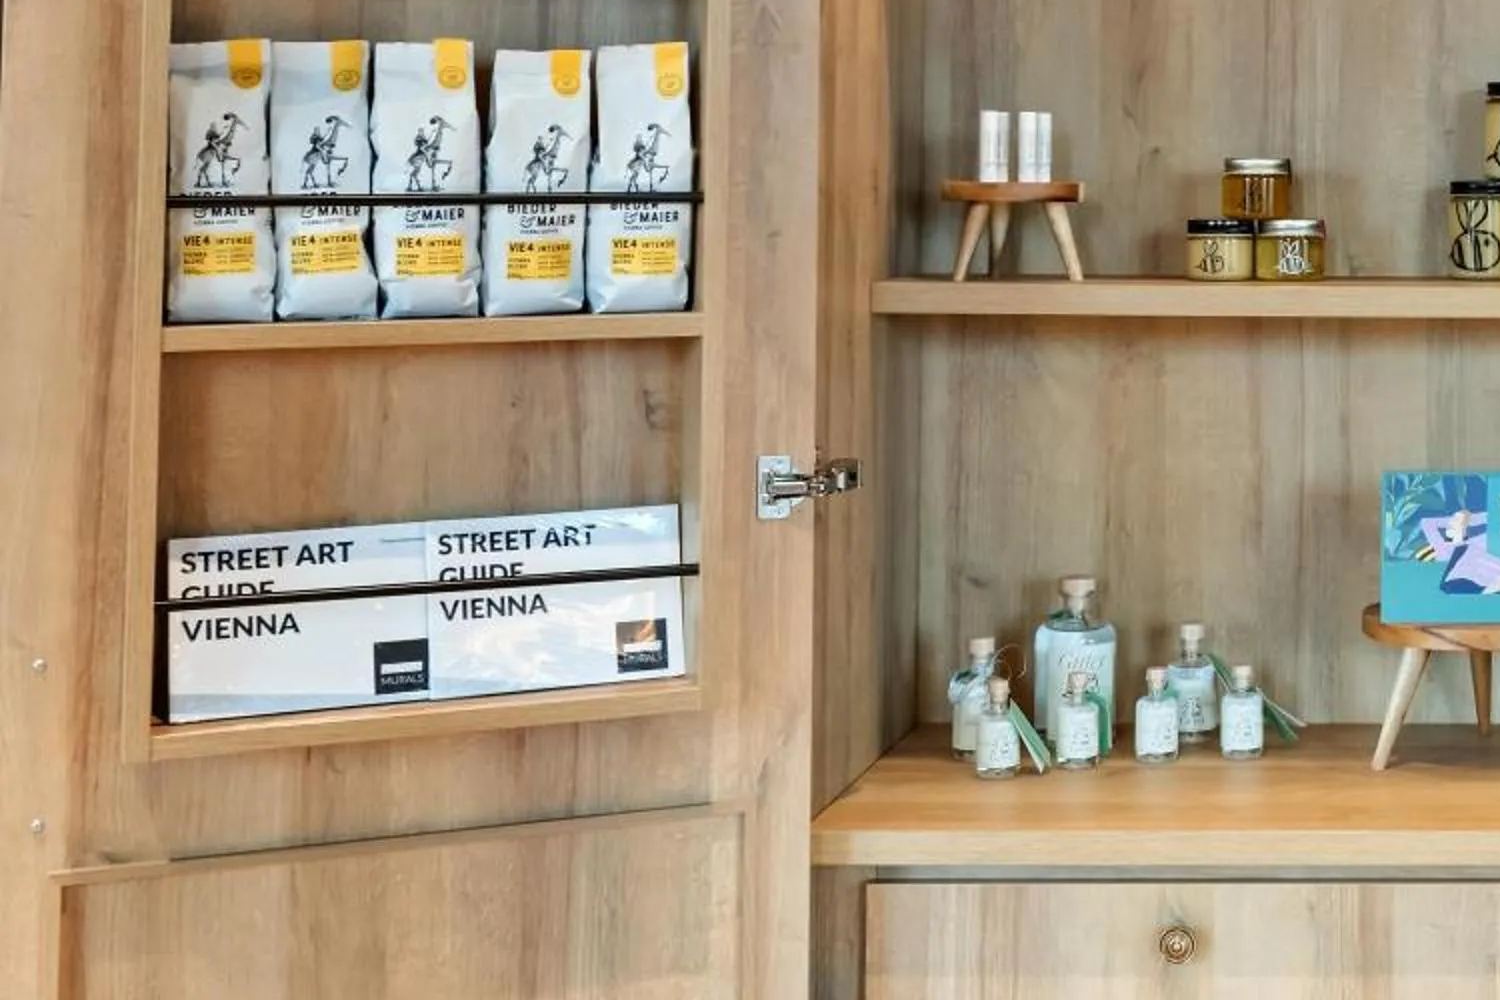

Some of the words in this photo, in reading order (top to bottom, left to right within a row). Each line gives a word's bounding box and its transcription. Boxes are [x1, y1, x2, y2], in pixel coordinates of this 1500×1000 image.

[211, 207, 255, 217] MAIER
[421, 208, 465, 221] MAIER
[537, 214, 576, 227] MAIER
[639, 211, 679, 223] MAIER
[438, 528, 536, 556] STREET
[542, 524, 596, 549] ART
[180, 545, 289, 574] STREET
[295, 541, 354, 567] ART
[440, 593, 548, 622] VIENNA
[182, 613, 300, 642] VIENNA
